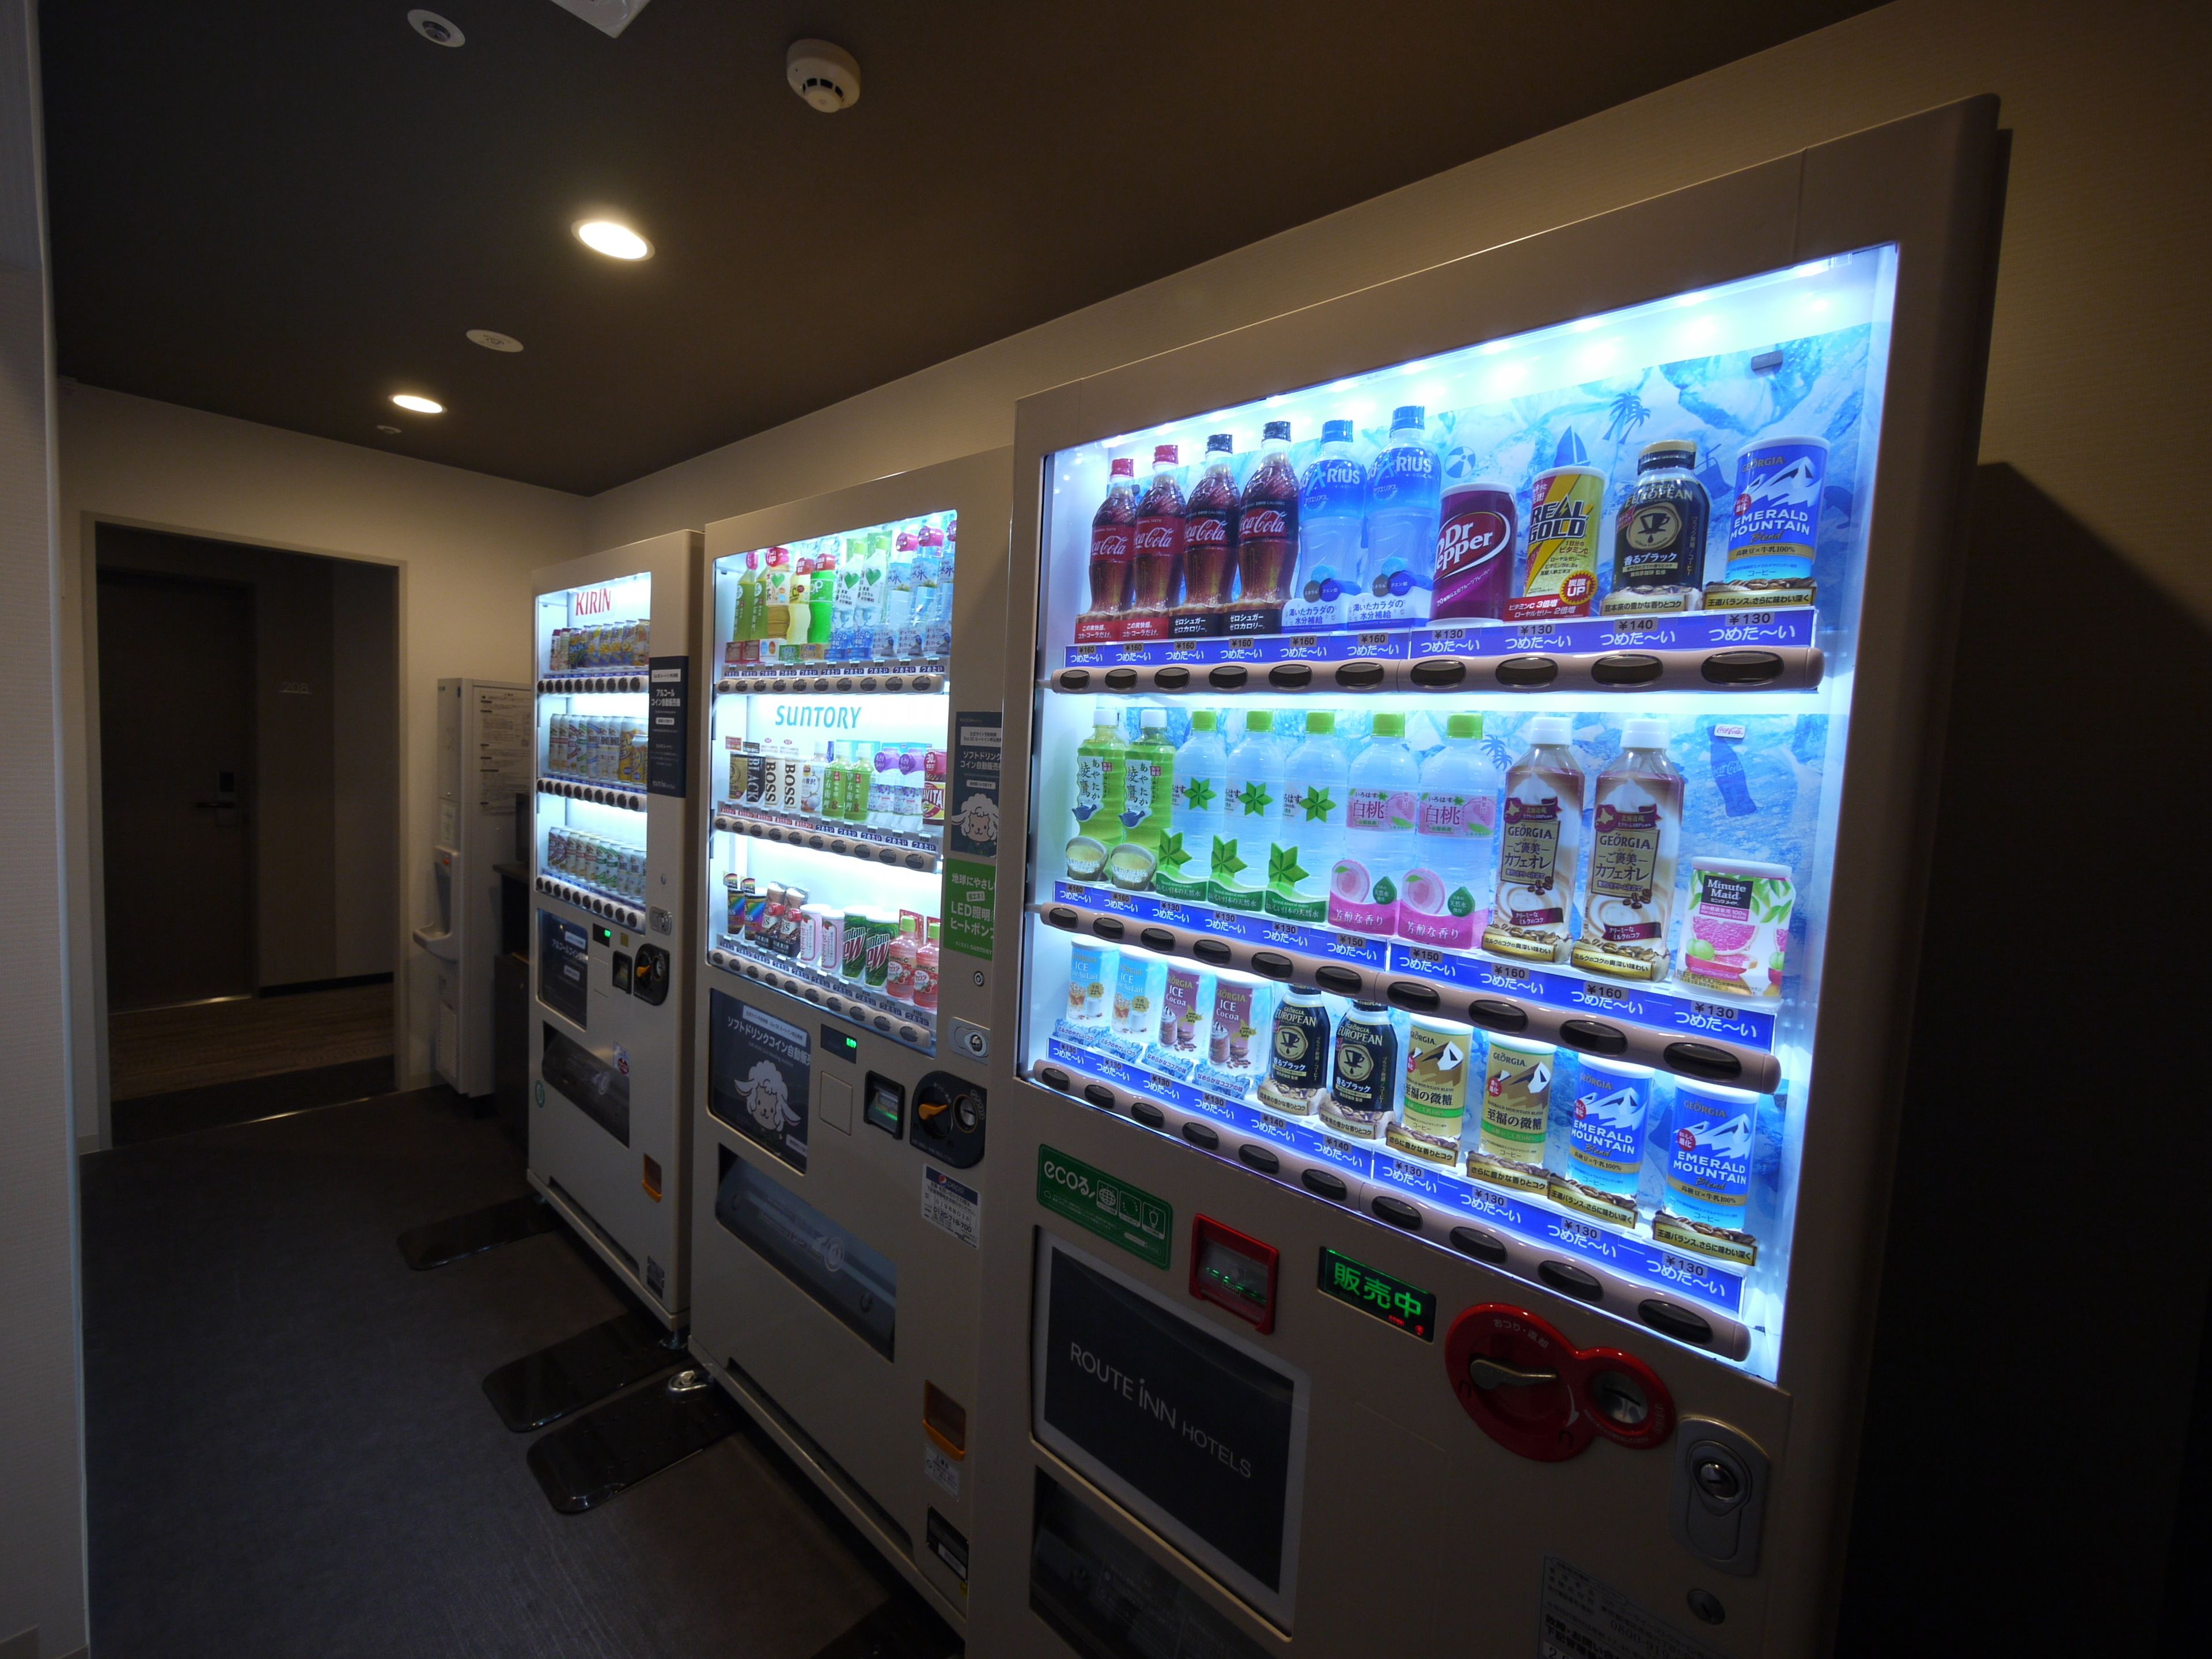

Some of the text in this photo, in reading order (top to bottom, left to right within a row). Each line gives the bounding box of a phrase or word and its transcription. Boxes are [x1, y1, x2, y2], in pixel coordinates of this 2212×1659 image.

[1532, 495, 1589, 521] REAL
[1734, 509, 1808, 529] EMERALD
[1446, 522, 1474, 546] Dr
[1528, 518, 1588, 545] GOLD
[1730, 520, 1810, 541] MOUNTAIN
[1623, 552, 1677, 566] 香るブラック
[1568, 579, 1585, 587] 炭酸
[1567, 586, 1585, 597] UP
[575, 588, 611, 616] KIRIN
[1604, 600, 1681, 612] 豆本来の豊かな香りとコク
[1175, 618, 1206, 626] ゼロシュガー
[1230, 613, 1264, 622] ゼロシュガー
[1295, 616, 1323, 625] 水分補給
[1360, 610, 1391, 620] 水分補給
[1729, 612, 1770, 625] ¥130
[1520, 625, 1552, 635] ¥130
[1619, 619, 1653, 630] ¥140
[1293, 637, 1314, 645] ¥160
[1361, 635, 1385, 643] ¥160
[1434, 630, 1463, 639] ¥130
[1125, 643, 1142, 652] ¥160
[1176, 642, 1194, 650] ¥160
[1232, 639, 1251, 647] ¥160
[775, 704, 862, 729] SUNTORY
[748, 755, 760, 801] BLACK
[766, 762, 777, 802] BOSS
[785, 763, 796, 805] BOSS
[1091, 759, 1100, 800] あやたか
[1138, 763, 1148, 806] あやたか
[1428, 795, 1453, 803] いろはす
[1353, 800, 1385, 819] 白桃
[1425, 804, 1461, 825] 白桃
[1508, 824, 1556, 840] GEORGIA
[1600, 832, 1654, 850] GEORGIA
[1504, 853, 1552, 870] カフェオレ
[1594, 864, 1650, 882] カフェオレ
[952, 872, 996, 891] 地球にやさし
[1707, 879, 1747, 893] Minute
[1710, 888, 1740, 900] Maid
[1161, 903, 1180, 911] ¥130
[1215, 913, 1235, 922] ¥130
[1335, 908, 1384, 927] 芳醇な香り
[1519, 917, 1544, 925] ミルクのコク
[1274, 923, 1296, 933] ¥130
[1406, 920, 1459, 940] 芳醇な香り
[1339, 935, 1363, 946] ¥150
[1613, 933, 1641, 941] ミルクのコク
[1484, 937, 1551, 954] ミルクのコクの奥深い味わい
[1412, 949, 1439, 962] ¥150
[1574, 953, 1649, 972] ミルクのコクの奥深い味わい
[1075, 961, 1088, 972] ICE
[1494, 965, 1526, 979] ¥160
[1120, 973, 1134, 984] ICE
[1169, 984, 1184, 998] ICE
[1587, 984, 1622, 998] ¥160
[1165, 994, 1187, 1006] Cocoa
[1220, 999, 1237, 1012] ICE
[1216, 1008, 1240, 1021] Cocoa
[1694, 1002, 1735, 1019] ¥130
[1275, 1009, 1316, 1028] EUROPEAN
[1058, 1026, 1094, 1041] ミルクのやさしいコク
[1338, 1025, 1382, 1047] EUROPEAN
[1100, 1038, 1136, 1056] ミルクのやさしいコク
[1273, 1056, 1306, 1071] 香るブラック
[1493, 1051, 1527, 1067] GEORGIA
[1152, 1074, 1170, 1087] ¥130
[1336, 1076, 1371, 1093] 香るブラック
[1204, 1093, 1224, 1107] ¥130
[1404, 1084, 1453, 1107] 至福の微糖
[1263, 1115, 1284, 1127] ¥140
[1412, 1122, 1433, 1131] コーヒー
[1487, 1108, 1543, 1131] 至福の微糖
[1573, 1119, 1634, 1144] EMERALD
[1326, 1138, 1349, 1152] ¥140
[1389, 1135, 1453, 1161] さらに豊かな香りとコク
[1571, 1128, 1635, 1156] MOUNTAIN
[1679, 1137, 1692, 1149] 進化
[1499, 1148, 1522, 1158] コーヒー
[1395, 1161, 1422, 1177] ¥130
[1677, 1150, 1746, 1175] EMERALD
[1470, 1166, 1546, 1191] さらに豊かな香りとコク
[1673, 1158, 1747, 1185] MOUNTAIN
[1582, 1176, 1606, 1187] コーヒー
[1475, 1189, 1505, 1206] ¥130
[1693, 1211, 1721, 1223] コーヒー
[1563, 1219, 1598, 1238] ¥130
[1665, 1254, 1704, 1277] ¥130
[1333, 1262, 1422, 1318] 販売中
[1070, 1341, 1134, 1403] ROUTE
[1182, 1420, 1252, 1479] HOTELS
